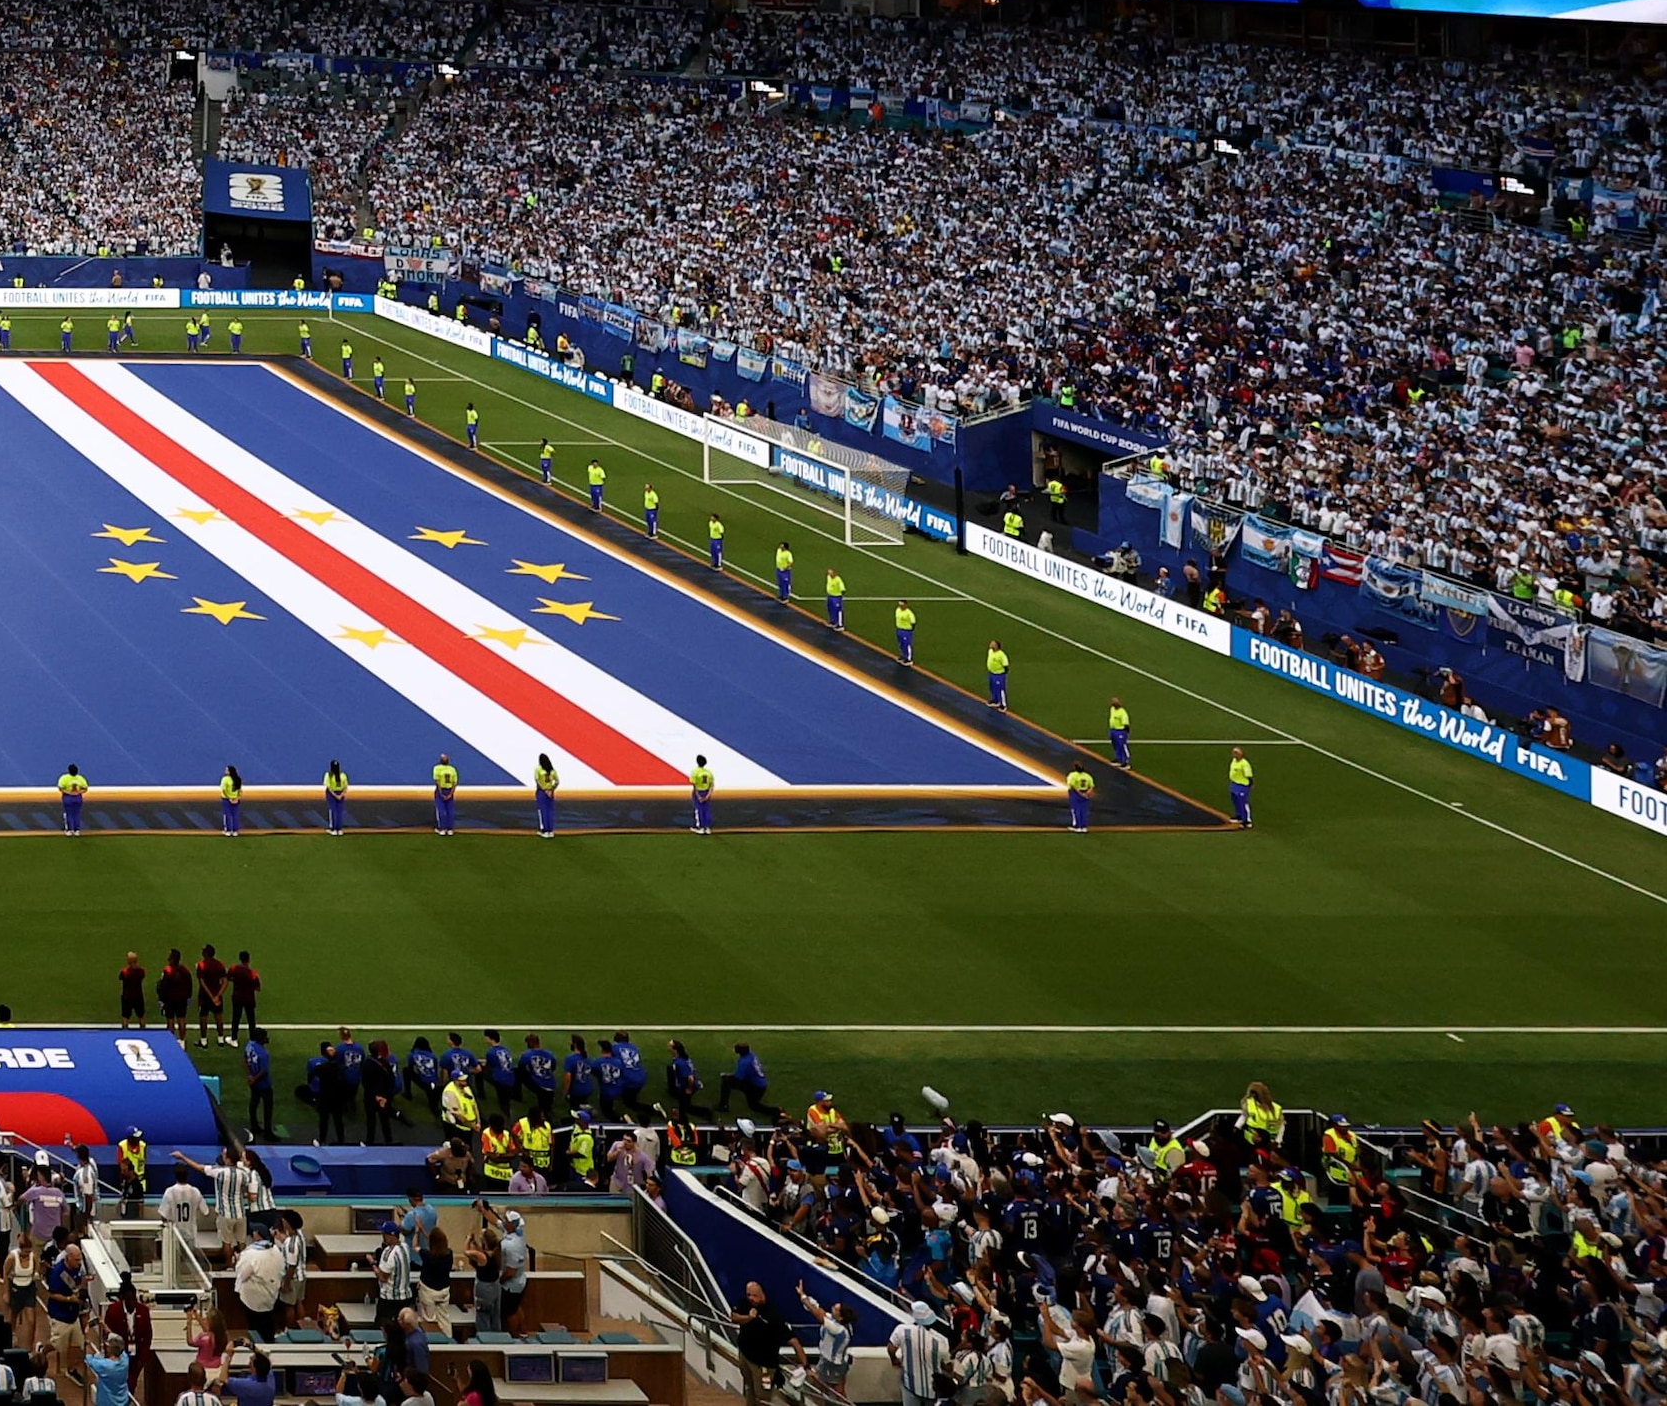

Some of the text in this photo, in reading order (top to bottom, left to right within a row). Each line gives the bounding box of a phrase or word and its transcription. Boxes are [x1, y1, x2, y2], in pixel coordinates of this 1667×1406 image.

[191, 291, 364, 310] FOOTBALL UNITES the World FIFA
[559, 301, 578, 320] FIFA
[1052, 417, 1149, 455] FIFA WORLD CUP 2026
[779, 451, 955, 535] FOOTBALL the World FIFA
[982, 534, 1209, 637] FOOTBALL UNITES the World FIFA
[1249, 637, 1566, 781] FOOTBALL UNITES the World FIFA
[176, 1202, 190, 1223] 10
[1023, 1218, 1038, 1240] 13
[1157, 1238, 1172, 1259] 13
